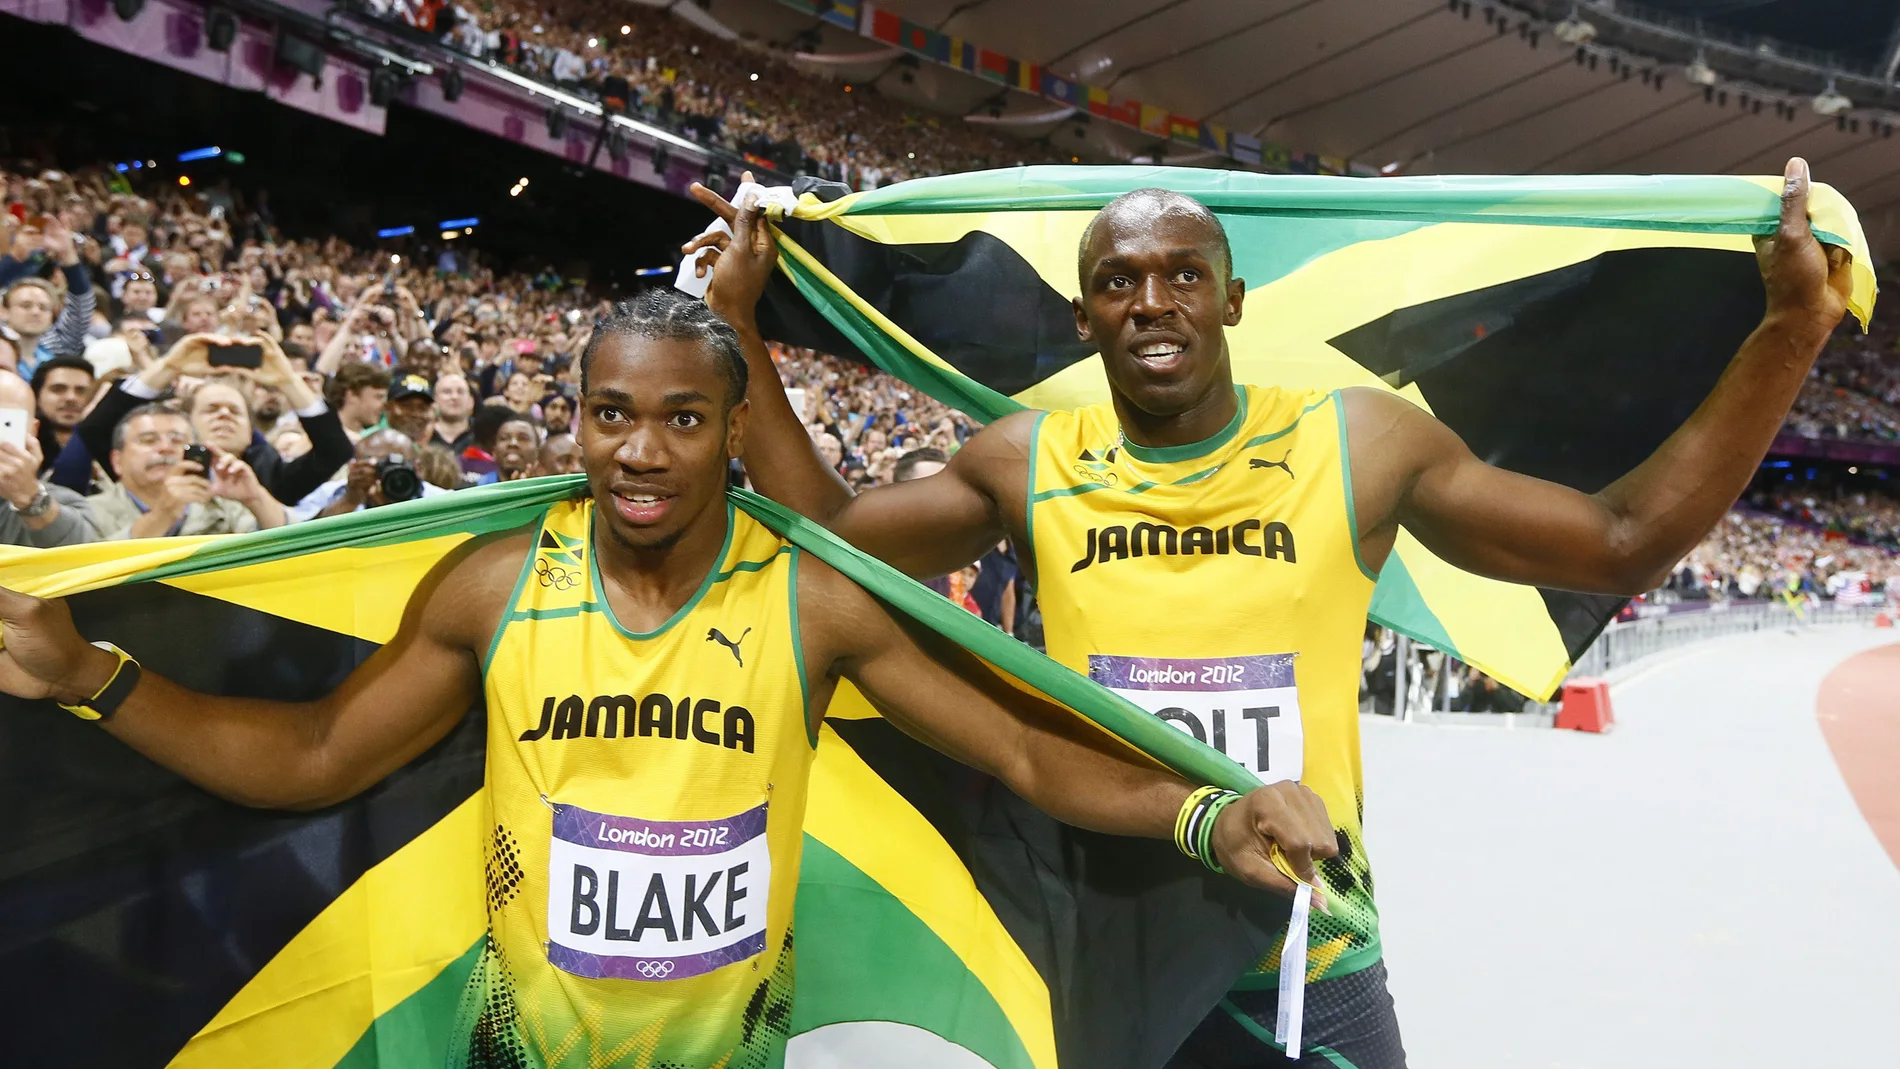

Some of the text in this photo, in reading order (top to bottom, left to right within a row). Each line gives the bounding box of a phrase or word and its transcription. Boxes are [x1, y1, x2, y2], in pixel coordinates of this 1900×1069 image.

[1071, 518, 1297, 574] JAMAICA
[1128, 663, 1245, 687] London 2012
[518, 693, 755, 754] JAMAICA
[597, 821, 729, 848] London 2012
[570, 861, 749, 943] BLAKE
